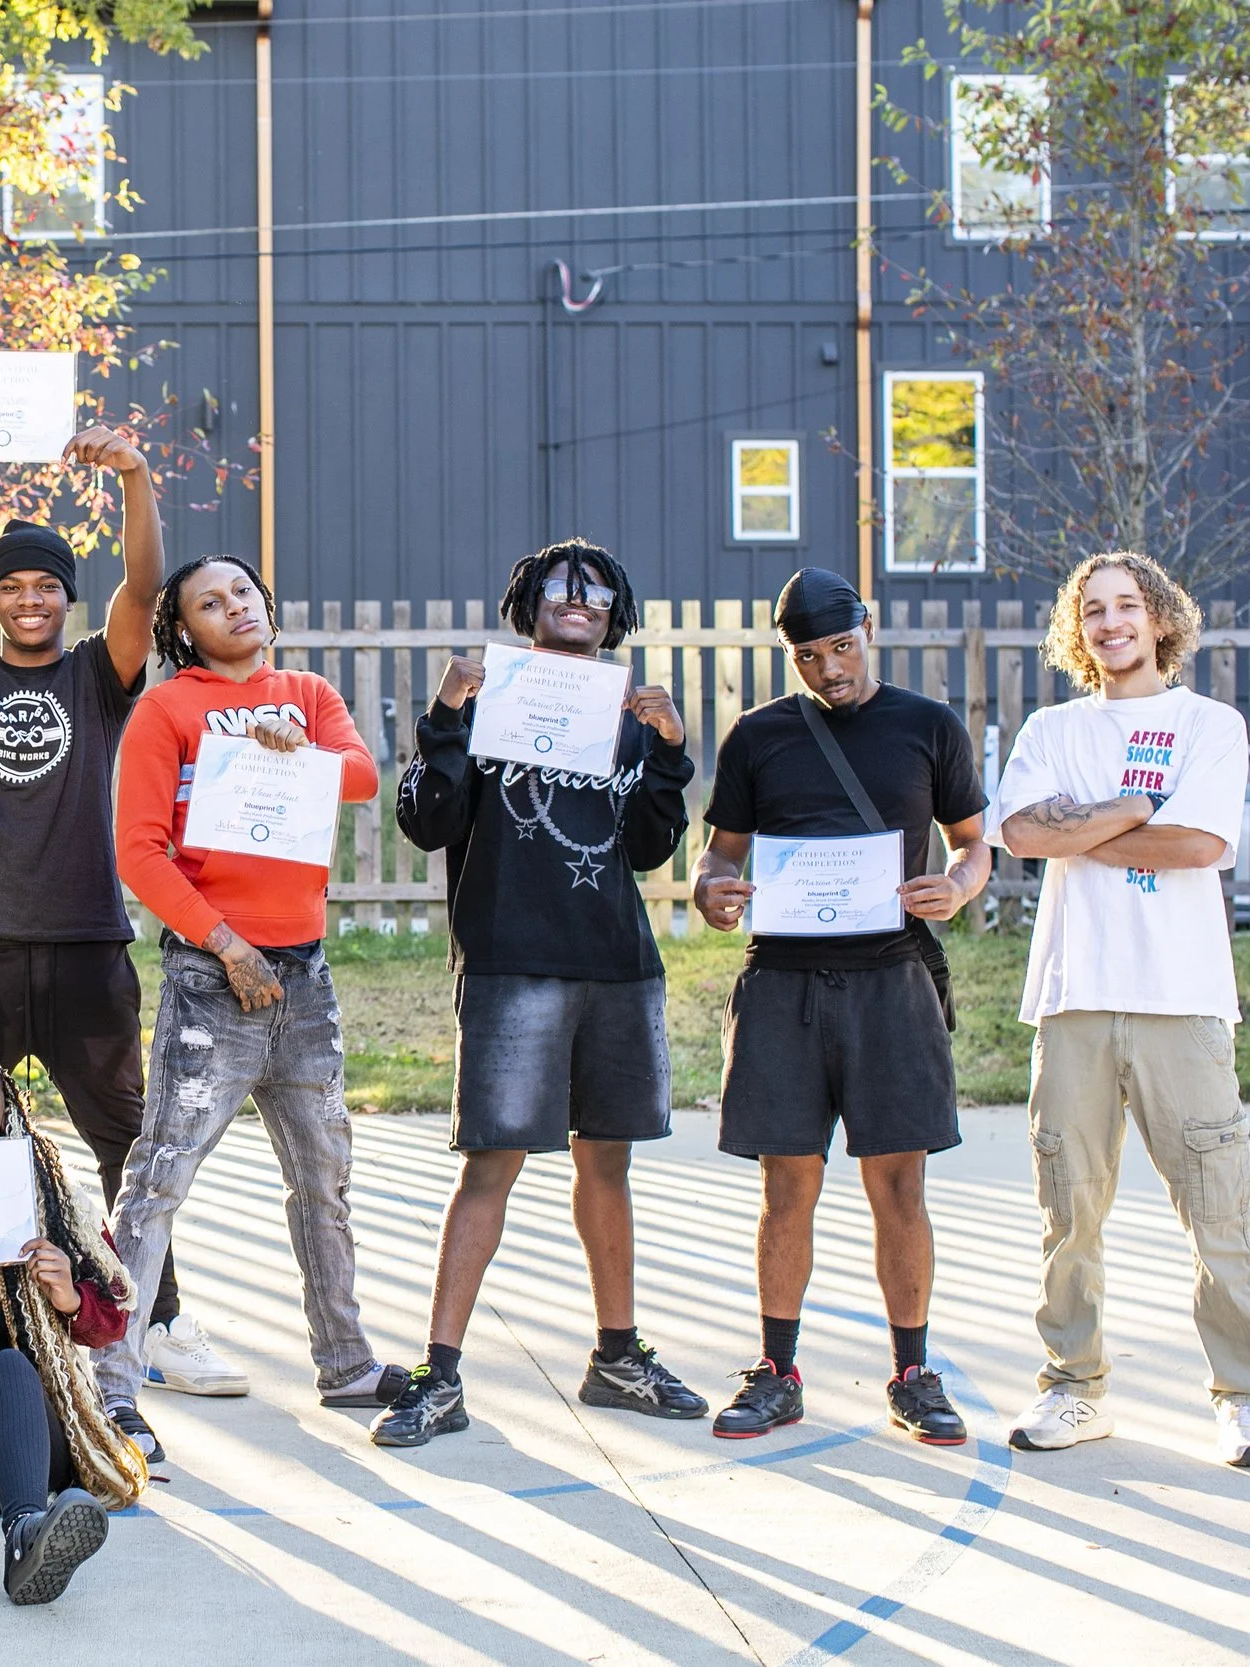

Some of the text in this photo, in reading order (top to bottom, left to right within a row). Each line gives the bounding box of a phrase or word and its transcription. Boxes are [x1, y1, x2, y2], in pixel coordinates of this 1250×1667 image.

[514, 663, 592, 682] CERTIFICATE OF
[519, 675, 582, 691] COMPLETION
[529, 713, 559, 724] blueprint
[1129, 730, 1175, 748] AFTER
[19, 751, 50, 761] WORKS
[227, 751, 308, 769] CERTIFICATE OF
[1126, 745, 1172, 766] SHOCK
[234, 763, 299, 779] COMPLETION
[1121, 768, 1164, 791] AFTER
[244, 802, 275, 813] blueprint
[784, 849, 863, 858] CERTIFICATE OF
[792, 859, 856, 868] COMPLETION
[807, 890, 839, 898] blueprint
